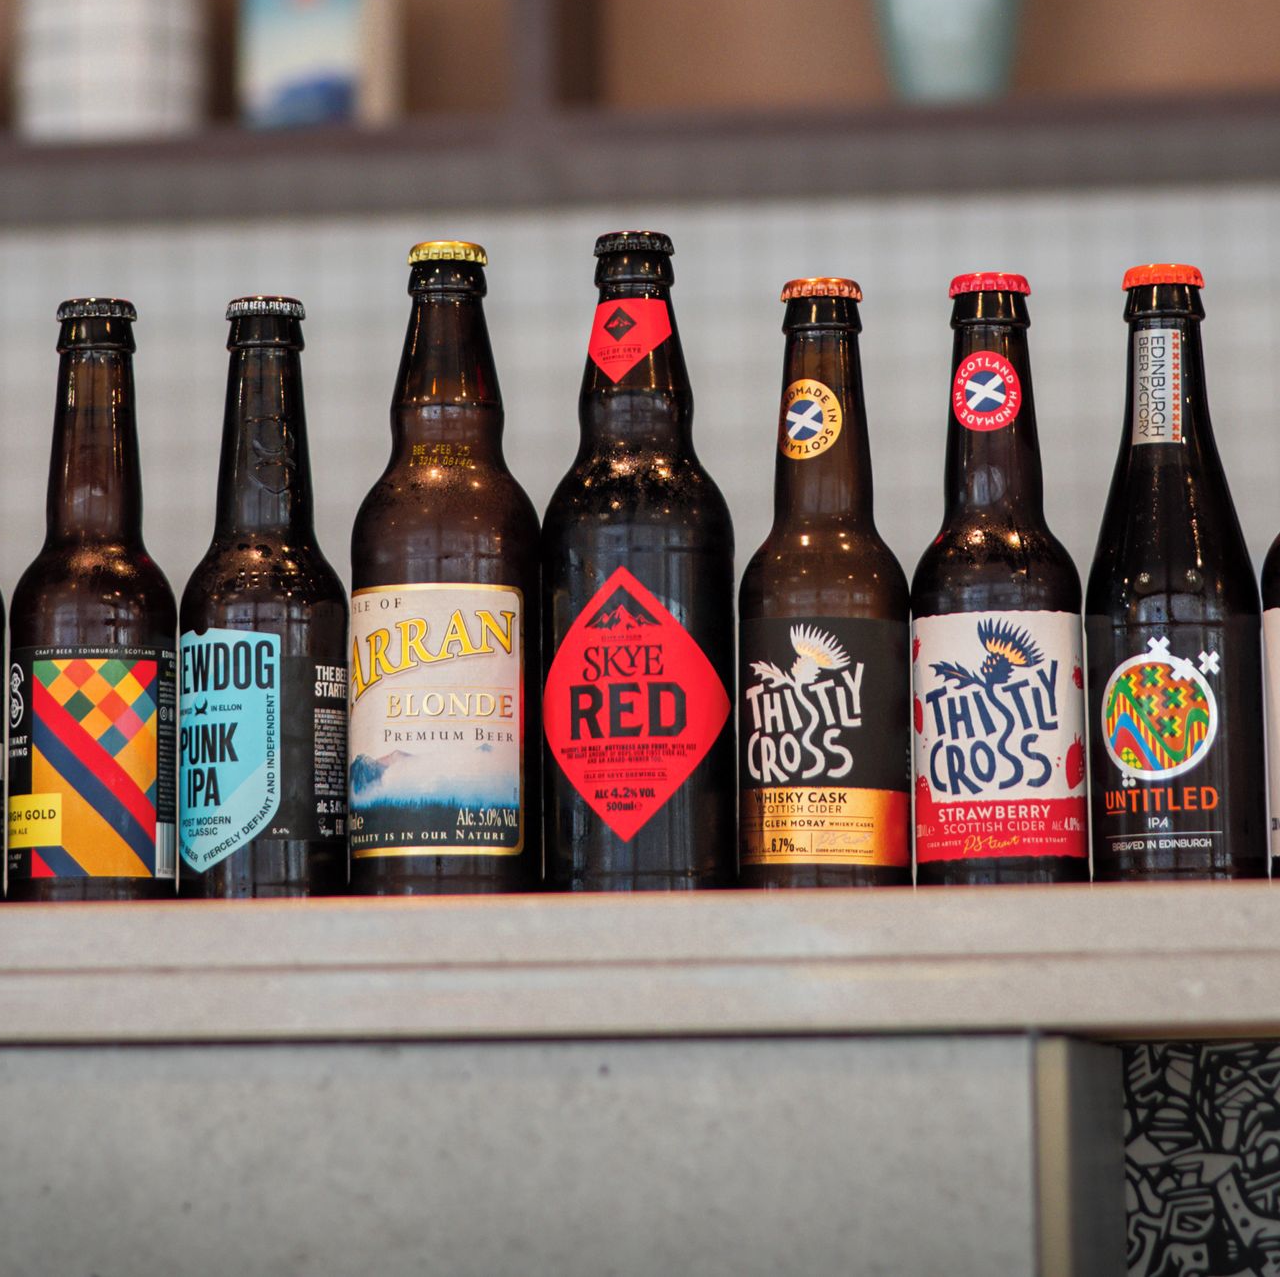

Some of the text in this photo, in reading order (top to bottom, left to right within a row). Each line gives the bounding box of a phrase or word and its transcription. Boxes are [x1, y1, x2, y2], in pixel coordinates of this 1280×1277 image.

[958, 357, 1014, 386] SCOTLAND
[1139, 336, 1149, 438] BEER FACTORY
[1151, 336, 1165, 437] EDINBURGH
[787, 386, 838, 423] DMADE IN
[955, 390, 1018, 426] HANDMADE IN
[380, 597, 402, 610] OF
[35, 648, 54, 656] CRAFT
[78, 647, 119, 655] EDINBURGH
[124, 648, 156, 656] SCOTLAND
[351, 608, 516, 707] ARRAN
[583, 644, 664, 682] SKYE
[180, 640, 275, 696] EWDOG
[315, 665, 335, 682] THE
[210, 703, 242, 712] IN ELLON
[386, 692, 514, 719] BLONDE
[746, 662, 865, 734] THISTLY
[926, 660, 1058, 740] THISTLY
[570, 682, 687, 740] RED
[180, 722, 239, 766] PUNK
[384, 727, 514, 742] PREMIUM BEER
[748, 728, 854, 783] CROSS
[930, 733, 1052, 795] CROSS
[187, 767, 221, 808] IPA
[203, 693, 275, 862] FIERCELY DEFIANT AND INDEPENDENT
[595, 787, 656, 799] ALC 4.2% VOL
[755, 792, 848, 804] WHISKY CASK
[1105, 785, 1219, 814] UNTITLED
[25, 808, 57, 820] GOLD
[456, 808, 476, 826] Alc.
[478, 809, 501, 827] 5.0%
[807, 804, 842, 814] CIDER
[938, 805, 1051, 823] STRAWBERRY
[188, 827, 218, 837] CLASSIC
[196, 816, 231, 826] MODERN
[764, 819, 787, 828] GLEN
[790, 819, 826, 828] MORAY
[944, 821, 1003, 835] SCOTTISH
[1007, 820, 1045, 832] CIDER
[1147, 816, 1169, 829] IPA
[771, 837, 795, 853] 6.7%
[1111, 838, 1212, 852] BREWED IN EDINBURGH
